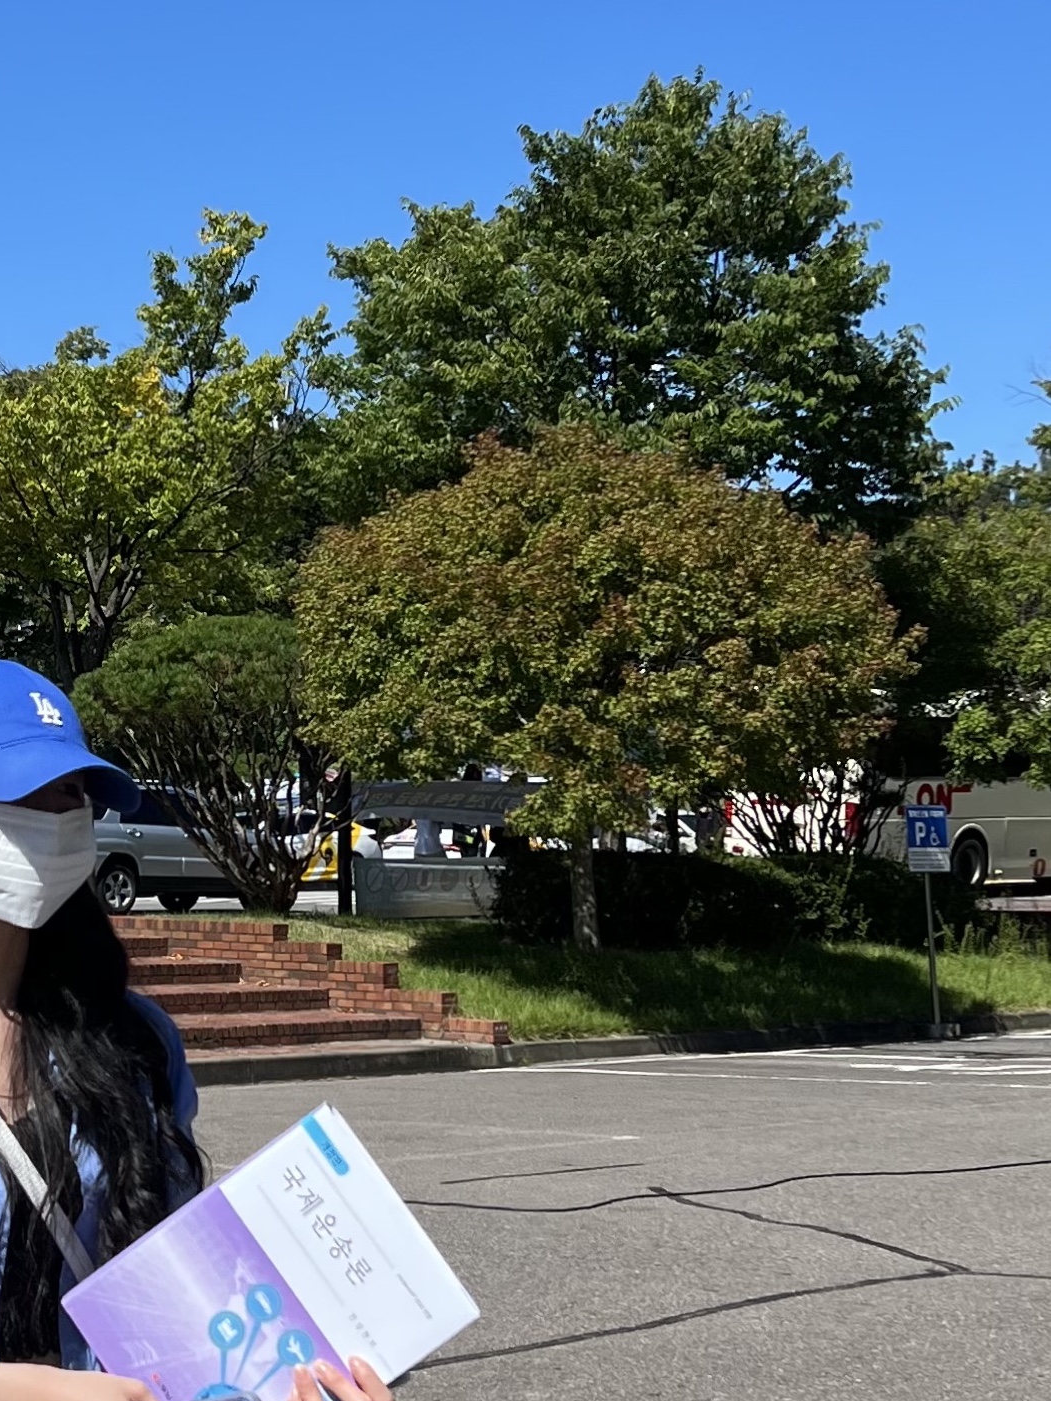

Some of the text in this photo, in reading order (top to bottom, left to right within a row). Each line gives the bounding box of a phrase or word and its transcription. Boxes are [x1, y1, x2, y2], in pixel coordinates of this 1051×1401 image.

[29, 692, 63, 725] LA
[914, 821, 926, 846] P
[282, 1164, 373, 1286] 국제운송론
